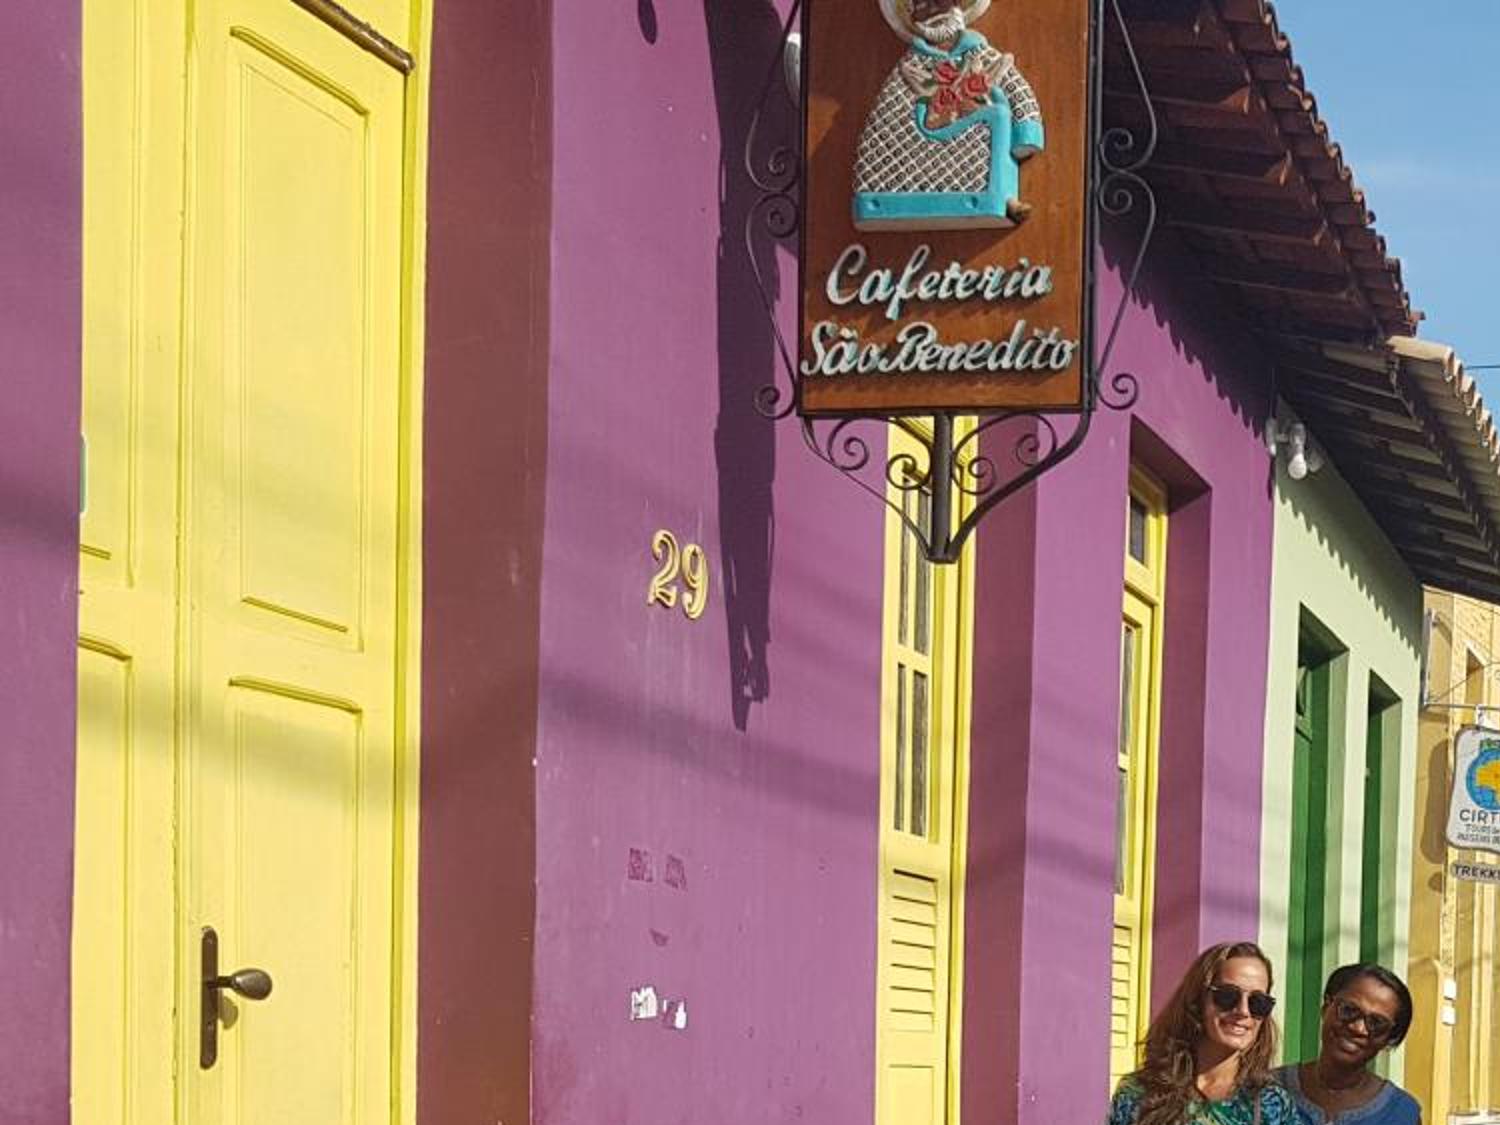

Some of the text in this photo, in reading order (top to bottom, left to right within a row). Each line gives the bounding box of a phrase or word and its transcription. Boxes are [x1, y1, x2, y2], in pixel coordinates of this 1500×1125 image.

[826, 243, 1053, 321] Cafeteria
[800, 319, 1079, 376] São Benedito
[647, 529, 709, 620] 29
